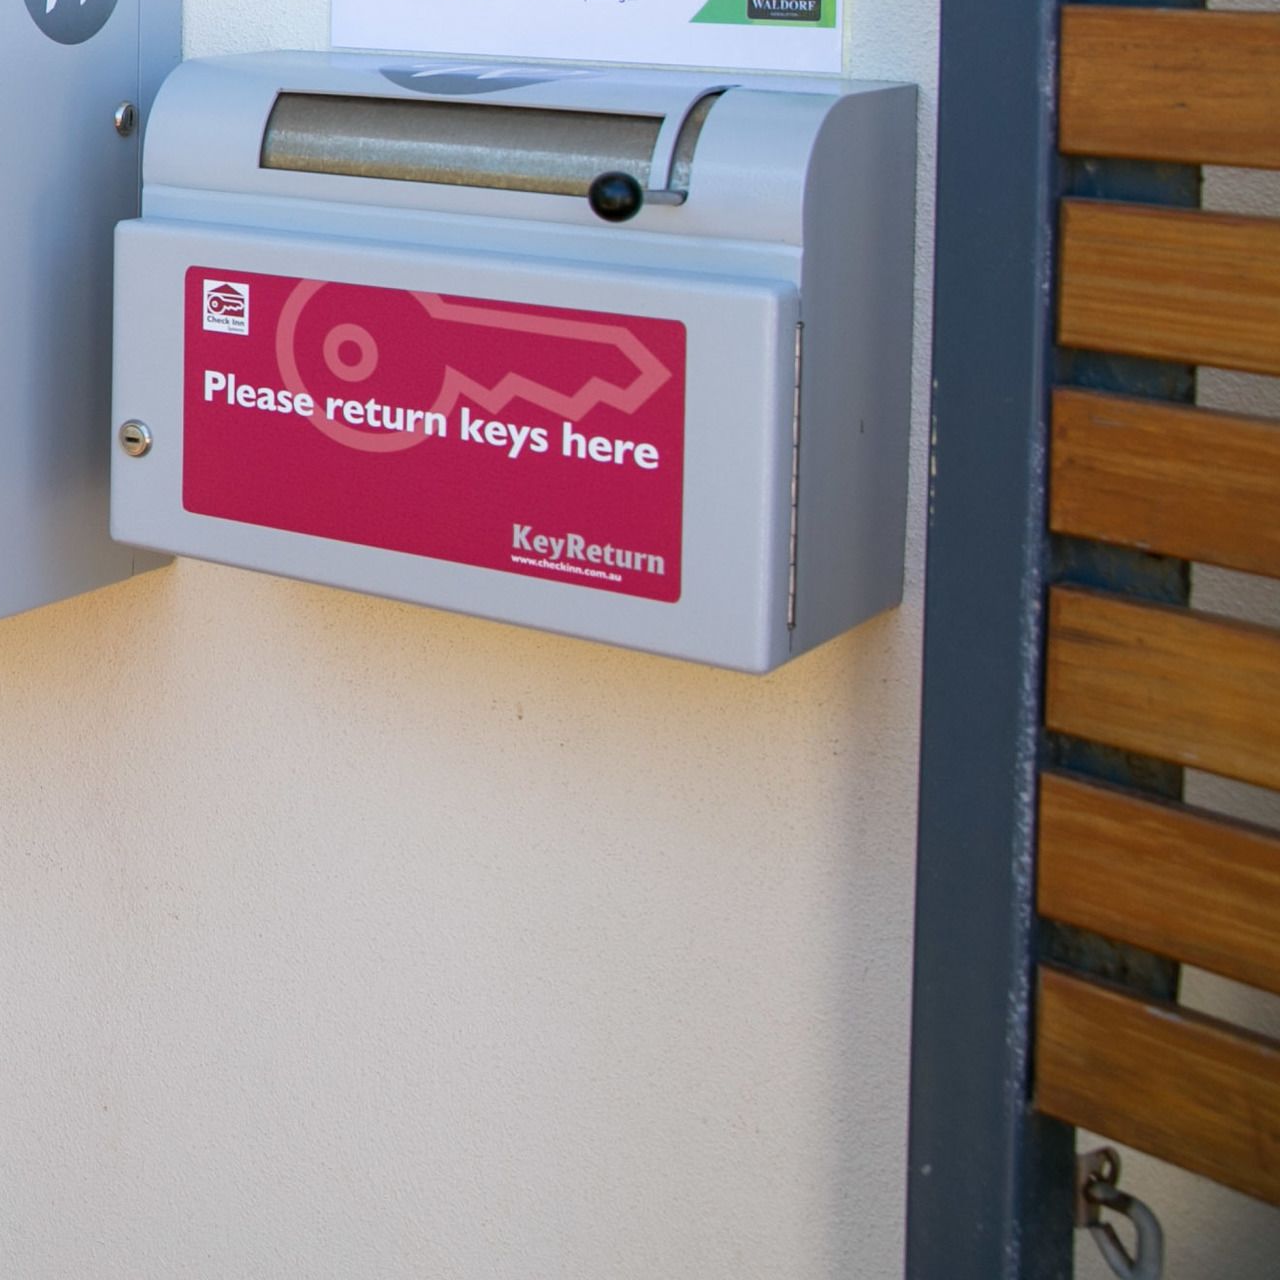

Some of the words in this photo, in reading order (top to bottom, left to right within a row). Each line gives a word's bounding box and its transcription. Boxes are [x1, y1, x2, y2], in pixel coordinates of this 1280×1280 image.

[753, 0, 816, 10] WALDORF
[207, 316, 229, 324] Check
[204, 370, 314, 418] Please
[326, 396, 447, 439] return
[461, 407, 549, 458] keys
[562, 422, 659, 470] here
[511, 523, 665, 577] KeyReturn
[511, 553, 622, 582] www.checkinn.com.au
